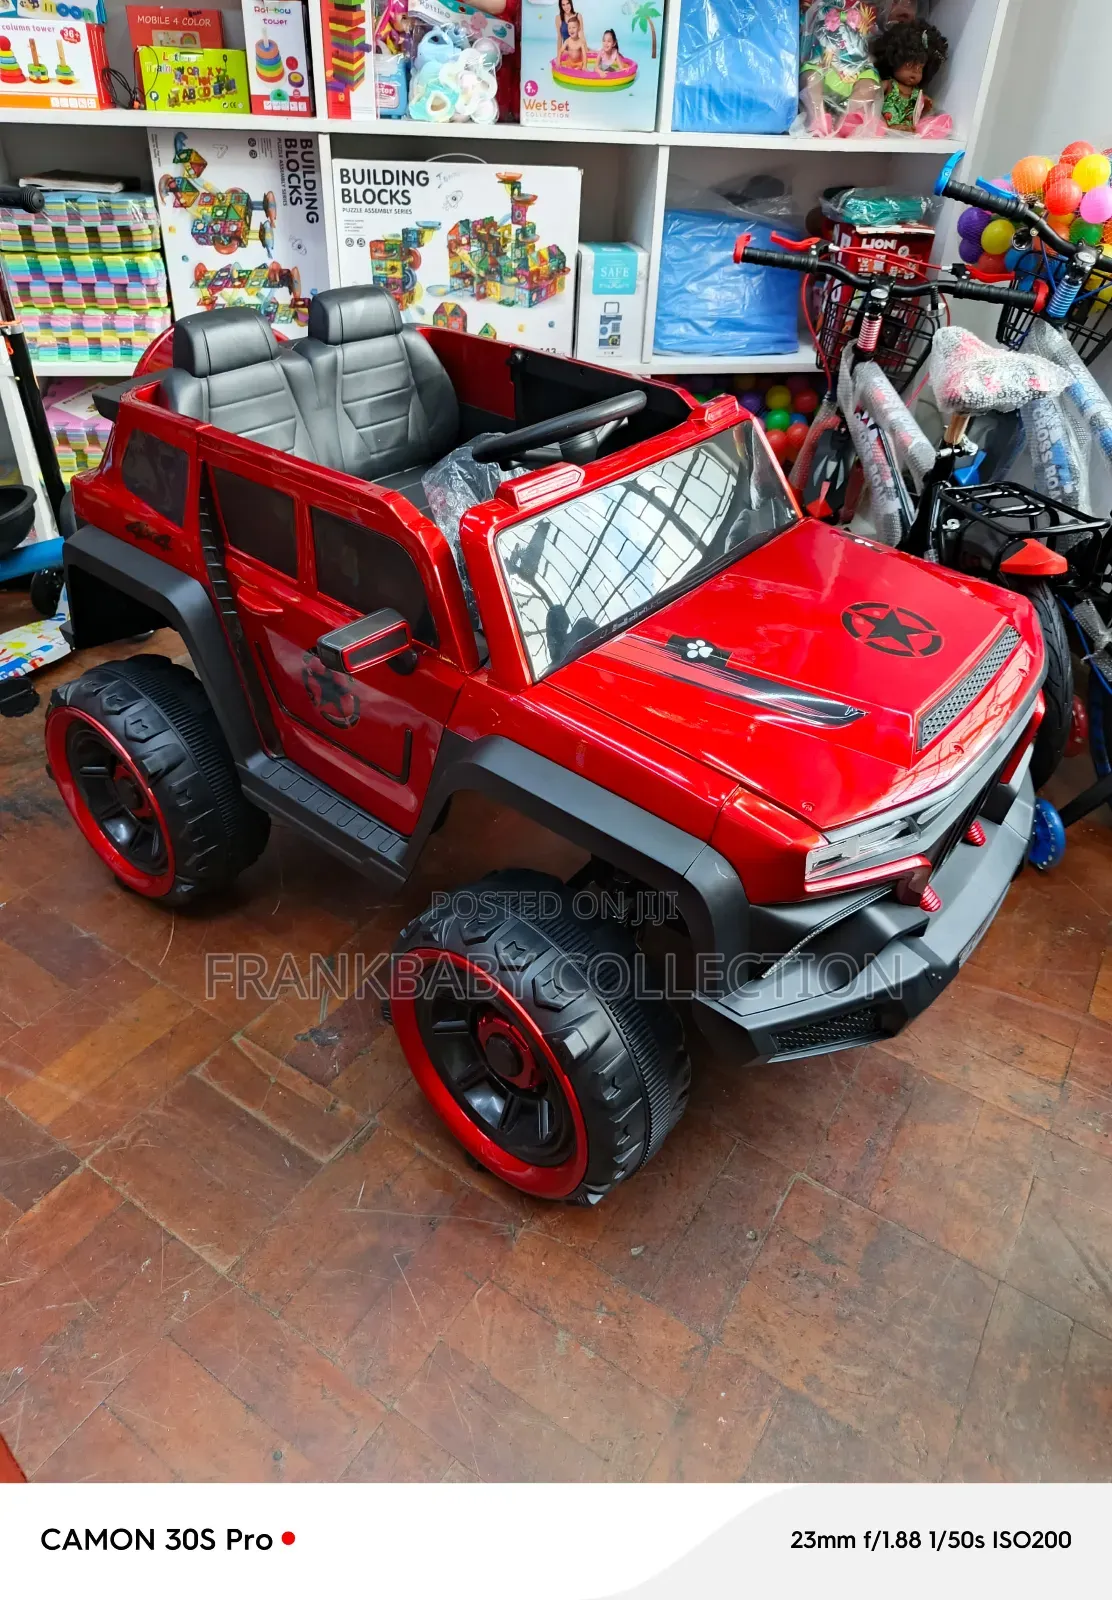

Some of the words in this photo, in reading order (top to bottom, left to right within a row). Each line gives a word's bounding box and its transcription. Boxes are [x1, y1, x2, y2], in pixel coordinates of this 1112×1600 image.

[254, 6, 291, 14] Raibow
[137, 15, 170, 25] MOBILE
[173, 17, 178, 25] 4
[181, 17, 212, 27] COLOR
[2, 23, 31, 32] column
[32, 25, 55, 33] tower
[523, 98, 548, 111] Wet
[550, 99, 570, 112] Set
[525, 111, 570, 119] COLLECTION
[284, 138, 303, 206] BLOCKS
[339, 168, 430, 187] BUILDING
[300, 138, 319, 224] BUILDING
[341, 188, 412, 206] BLOCKS
[364, 207, 393, 215] ASSEMBLY
[861, 238, 898, 251] LION
[600, 266, 630, 278] SAFE
[1045, 464, 1063, 502] ROA
